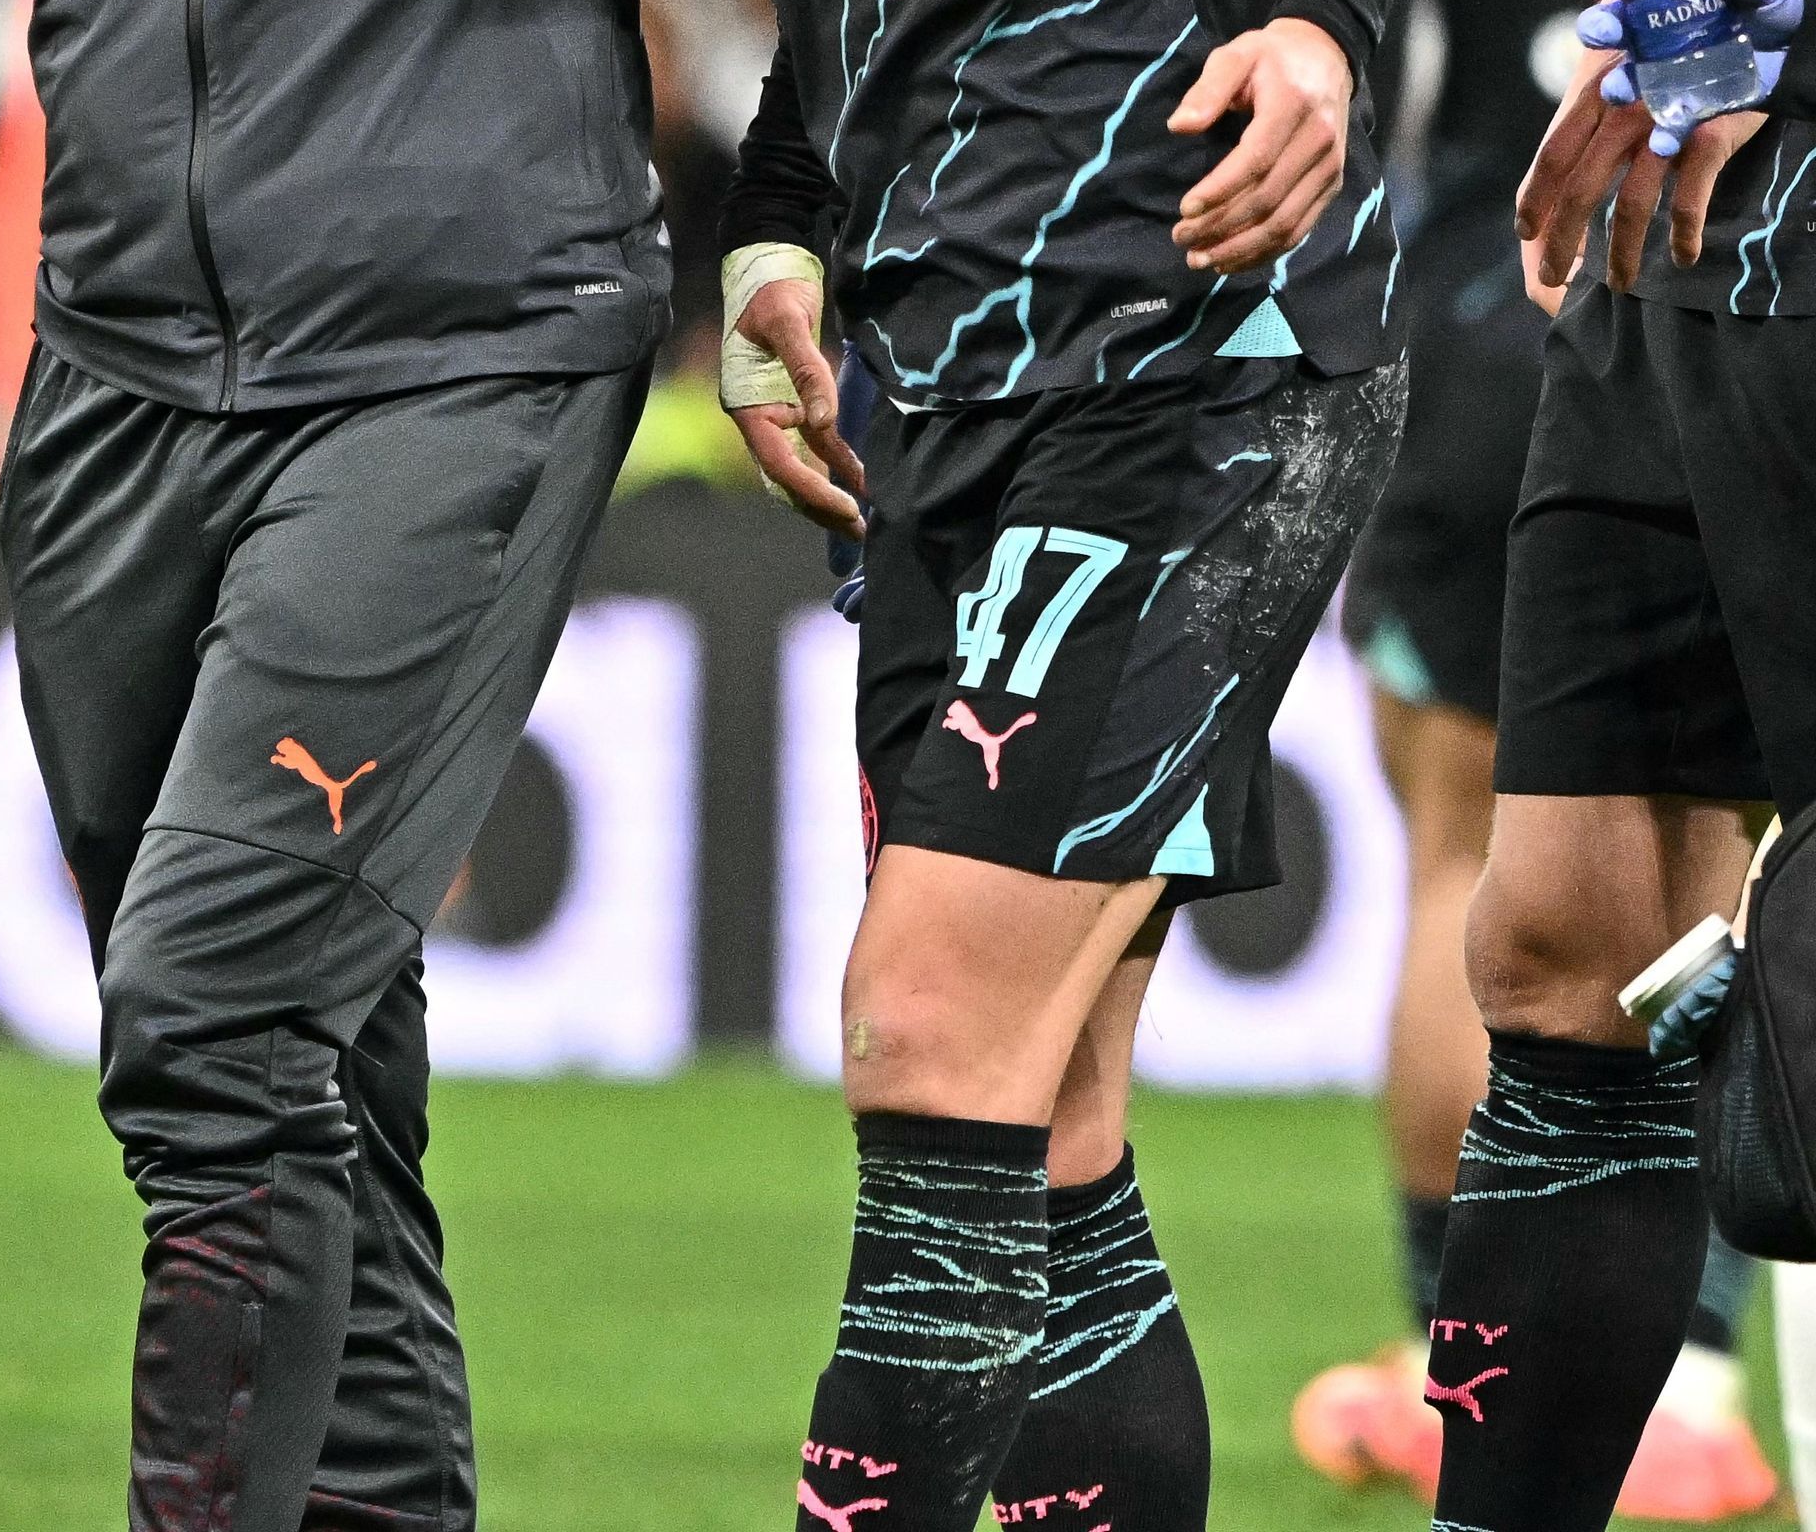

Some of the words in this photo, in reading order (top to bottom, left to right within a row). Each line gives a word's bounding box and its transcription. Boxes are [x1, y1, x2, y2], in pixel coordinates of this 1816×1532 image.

[574, 281, 623, 296] RAINCELL
[1110, 298, 1168, 319] ULTRAWEAVE
[955, 526, 1129, 699] 47
[1429, 1318, 1509, 1346] ITY
[800, 1439, 898, 1478] CITY
[991, 1483, 1104, 1524] CITY
